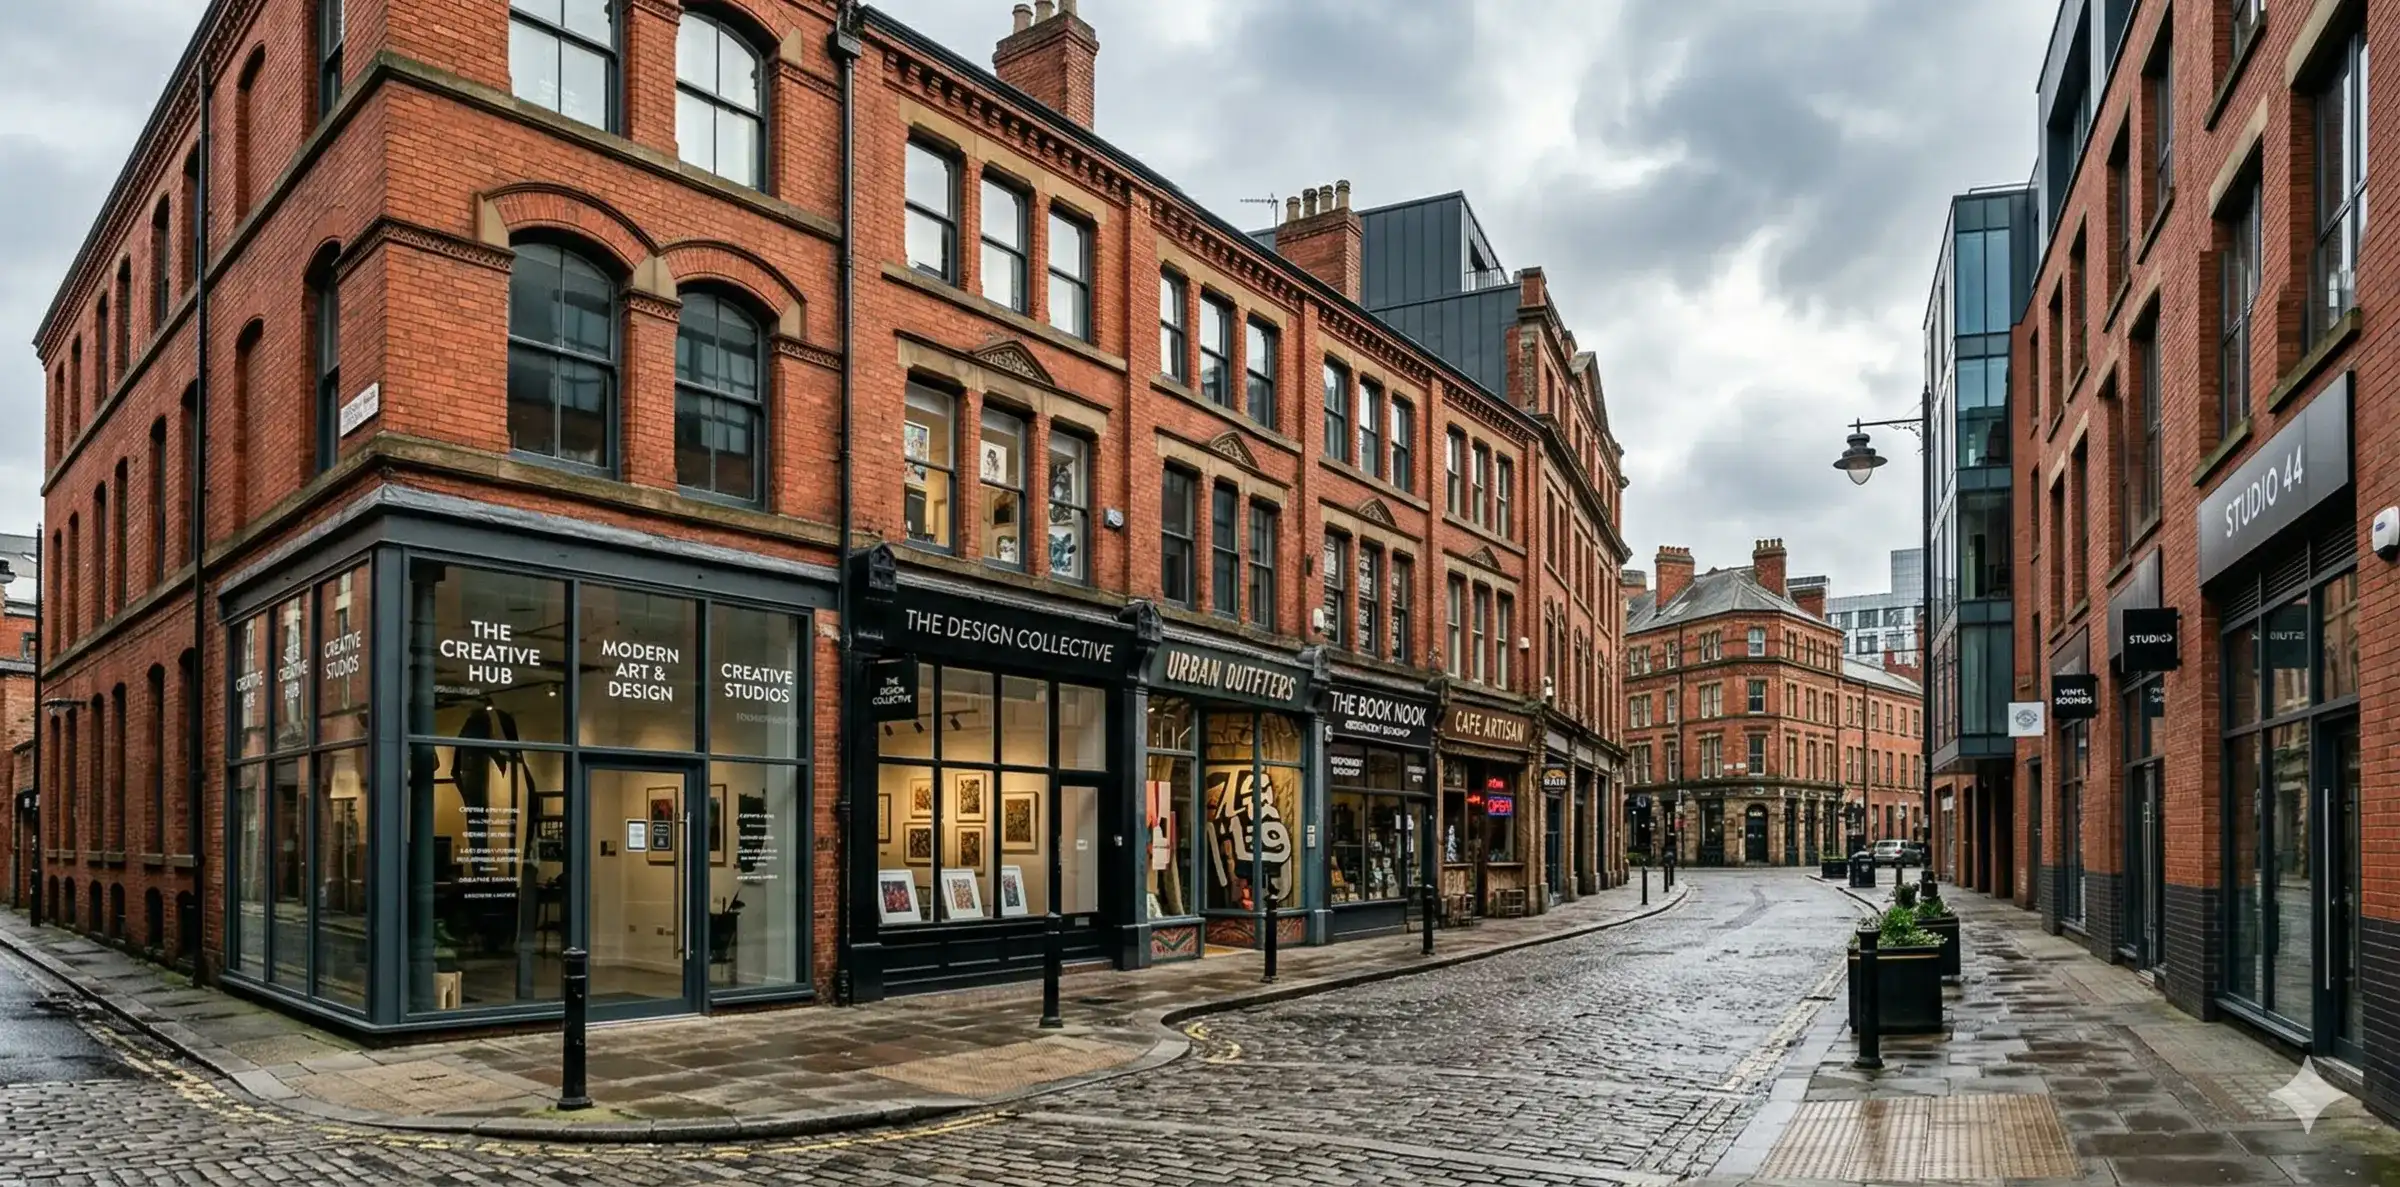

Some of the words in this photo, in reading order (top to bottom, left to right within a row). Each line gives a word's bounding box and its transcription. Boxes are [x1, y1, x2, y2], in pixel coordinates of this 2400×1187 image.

[2226, 467, 2278, 538] STUDIO
[2283, 444, 2303, 493] 44
[470, 620, 512, 641] THE
[906, 609, 943, 635] THE
[947, 617, 1013, 646] DESIGN
[1017, 629, 1114, 663] COLLECTIVE
[324, 630, 361, 658] CREATIVE
[439, 639, 541, 666] CREATIVE
[602, 640, 679, 664] MODERN
[326, 654, 359, 680] STUDIOS
[468, 664, 513, 684] HUB
[615, 662, 649, 680] ART
[654, 666, 666, 681] &
[721, 662, 794, 686] CREATIVE
[1166, 650, 1222, 688] URBAN
[608, 681, 673, 701] DESIGN
[724, 682, 790, 703] STUDIOS
[2060, 688, 2088, 697] VINYL
[1329, 690, 1357, 716] THE
[1358, 695, 1393, 722] BOOK
[1394, 702, 1426, 727] NOOK
[1455, 710, 1481, 736] CAFE
[1482, 716, 1525, 743] ARTISAN
